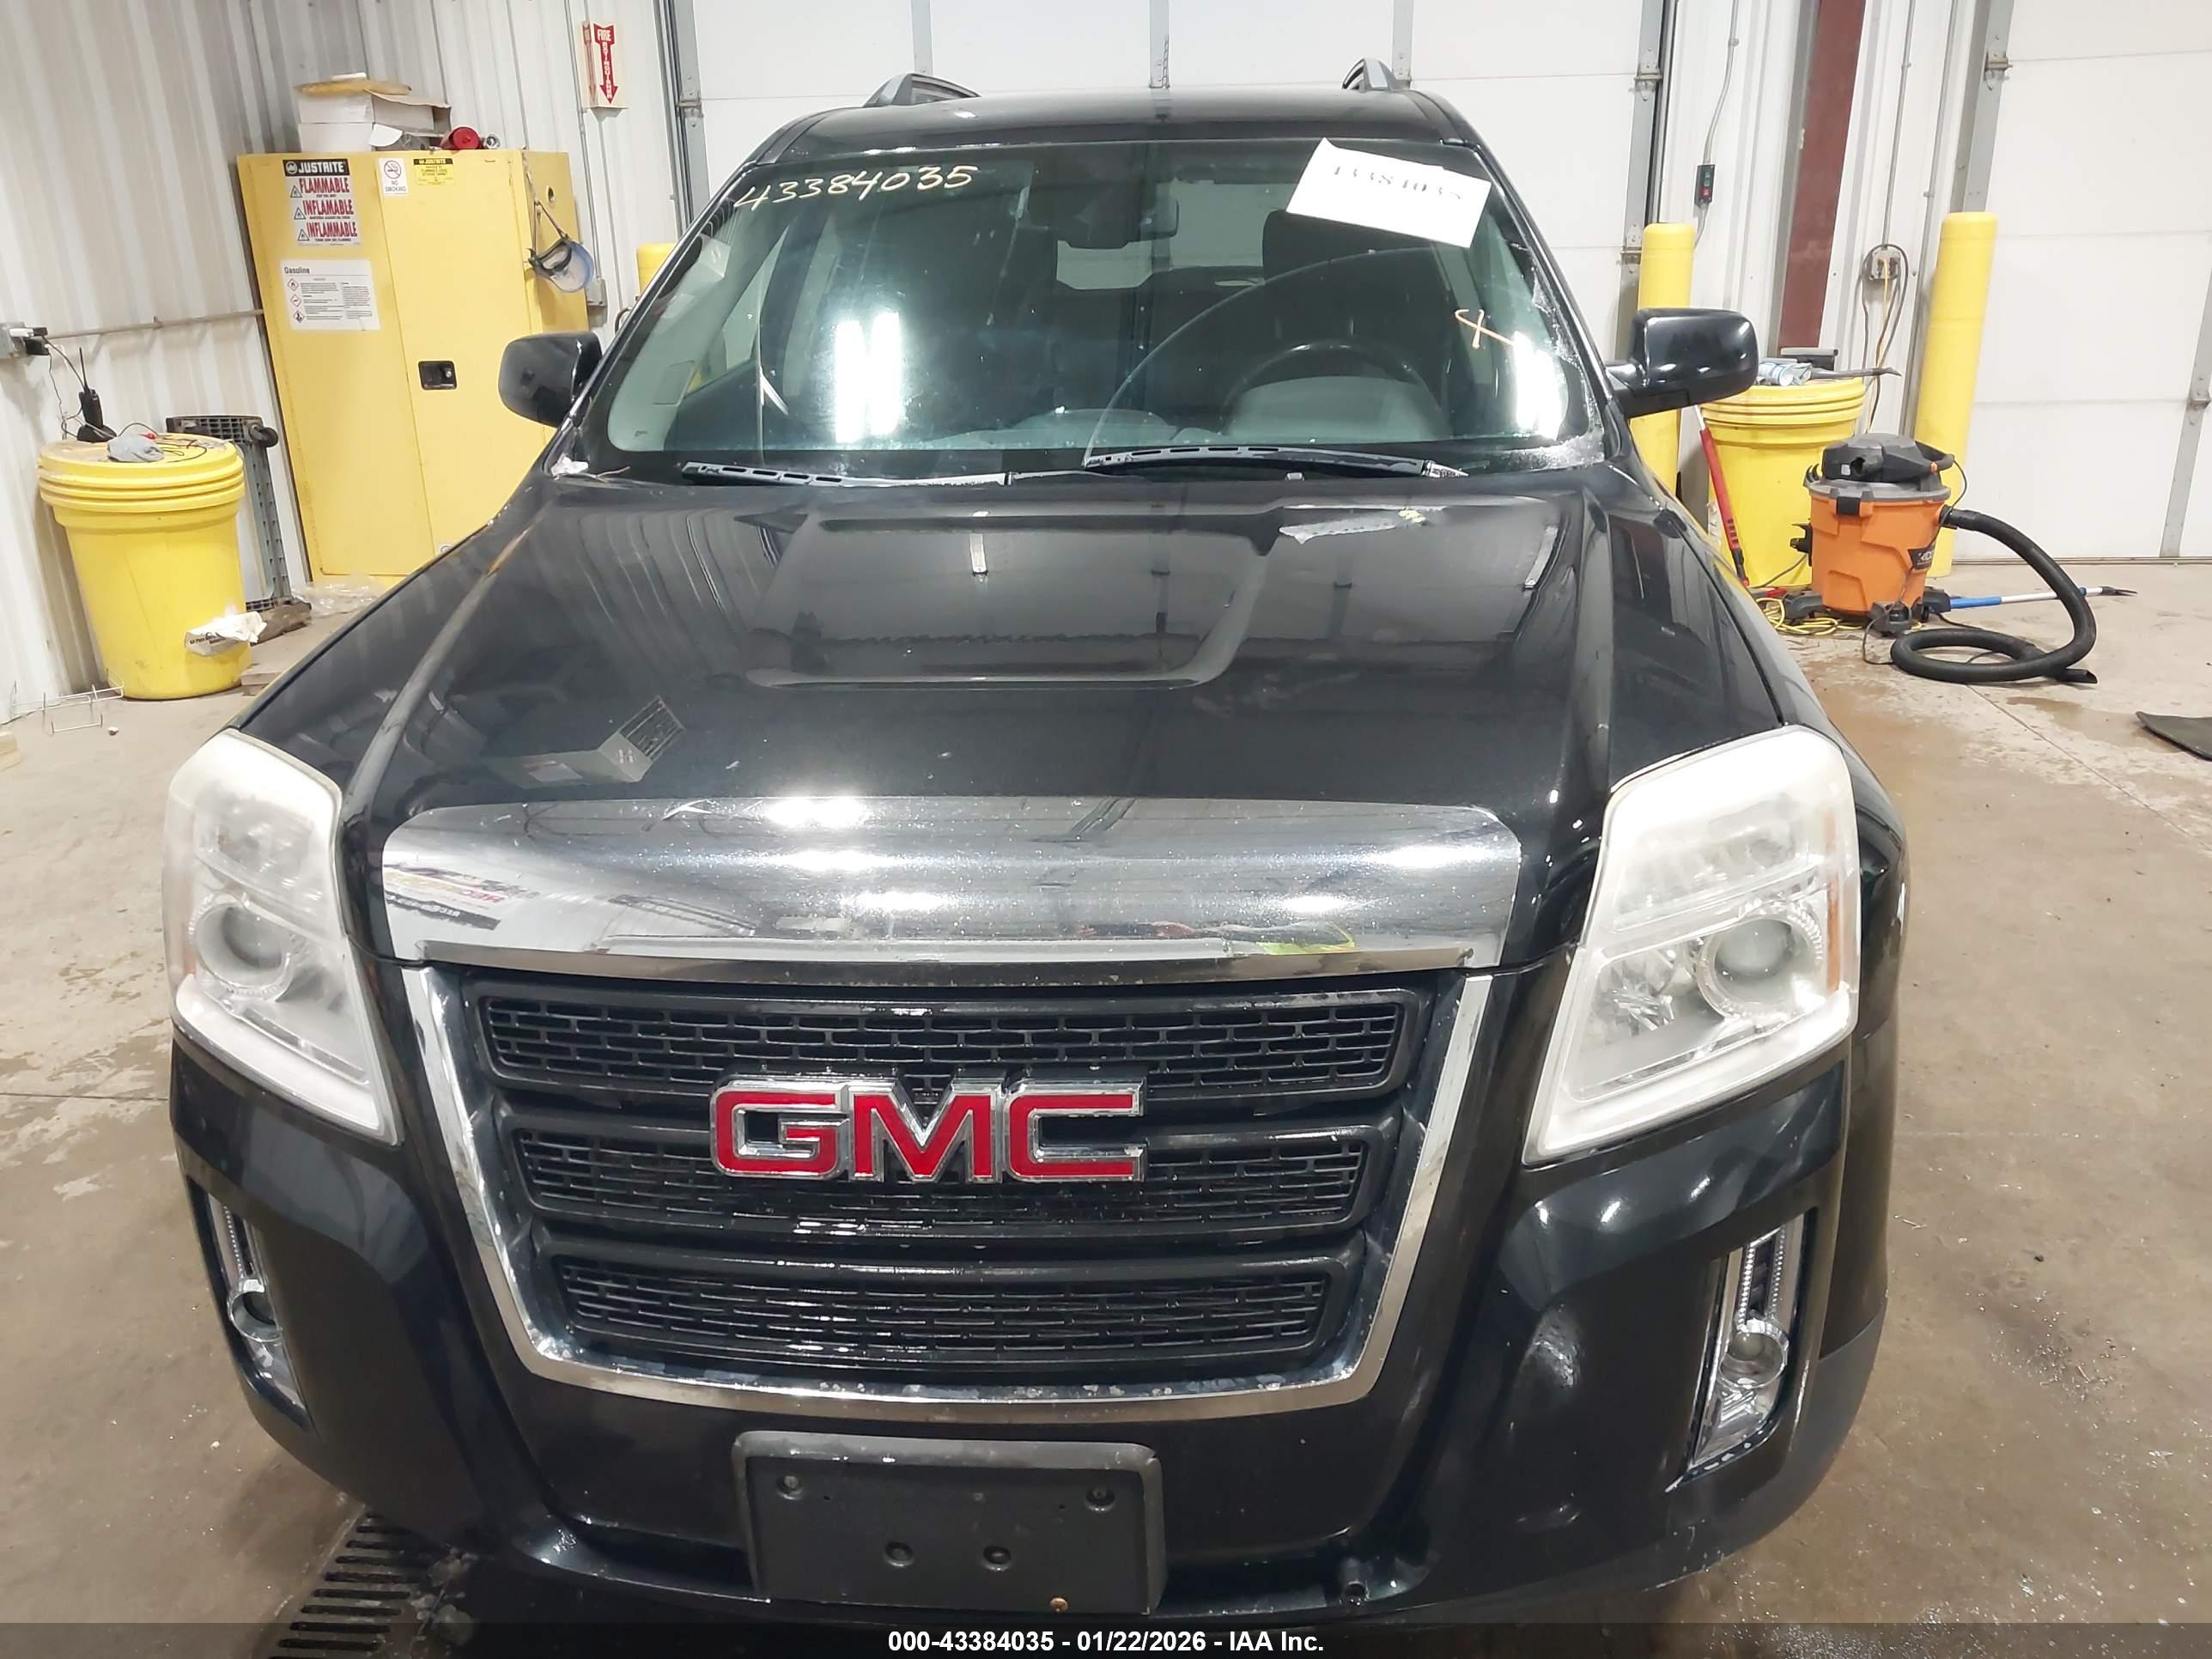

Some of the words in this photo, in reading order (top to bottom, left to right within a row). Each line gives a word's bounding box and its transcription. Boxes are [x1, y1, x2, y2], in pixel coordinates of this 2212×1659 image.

[597, 28, 611, 42] FIRE
[298, 161, 344, 173] JUSTRITE
[299, 177, 350, 194] FLAMMABLE
[733, 165, 979, 211] 43384035
[302, 199, 354, 216] INFLAMABLE
[306, 222, 357, 238] INFLAMMABLE
[283, 266, 310, 275] Gasoline
[709, 1075, 1147, 1183] GMC
